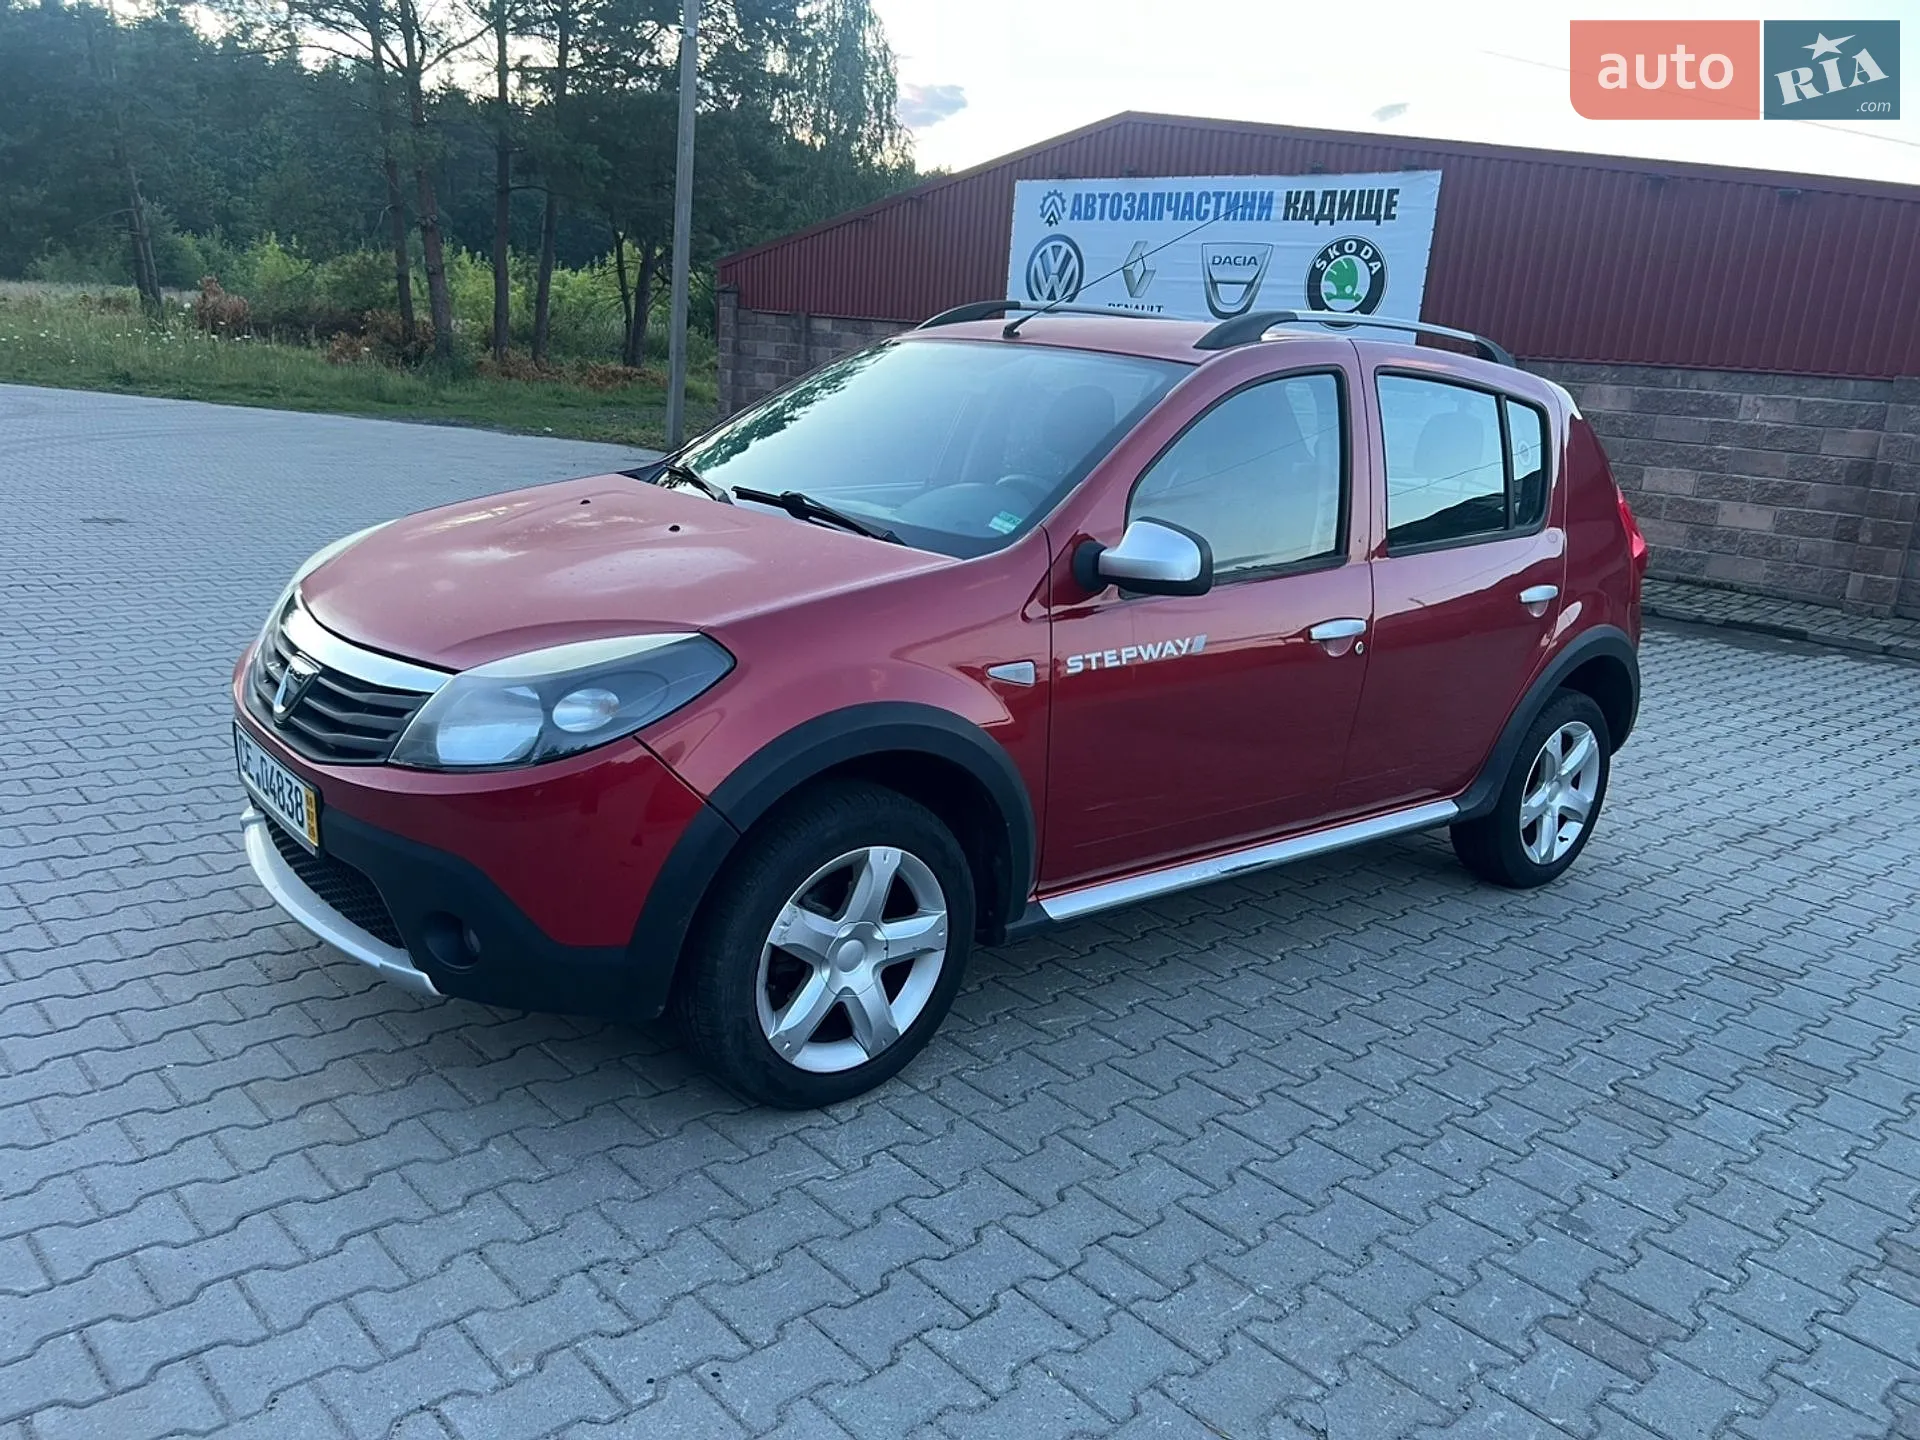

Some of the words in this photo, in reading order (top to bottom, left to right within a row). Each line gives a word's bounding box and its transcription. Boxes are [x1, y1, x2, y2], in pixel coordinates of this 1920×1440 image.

[1069, 191, 1274, 221] АВТОЗАПЧАСТИНИ
[1282, 188, 1400, 226] КАДИЩЕ
[1211, 255, 1259, 267] DACIA
[1315, 240, 1382, 275] SKODA
[1066, 637, 1192, 675] STEPWAY
